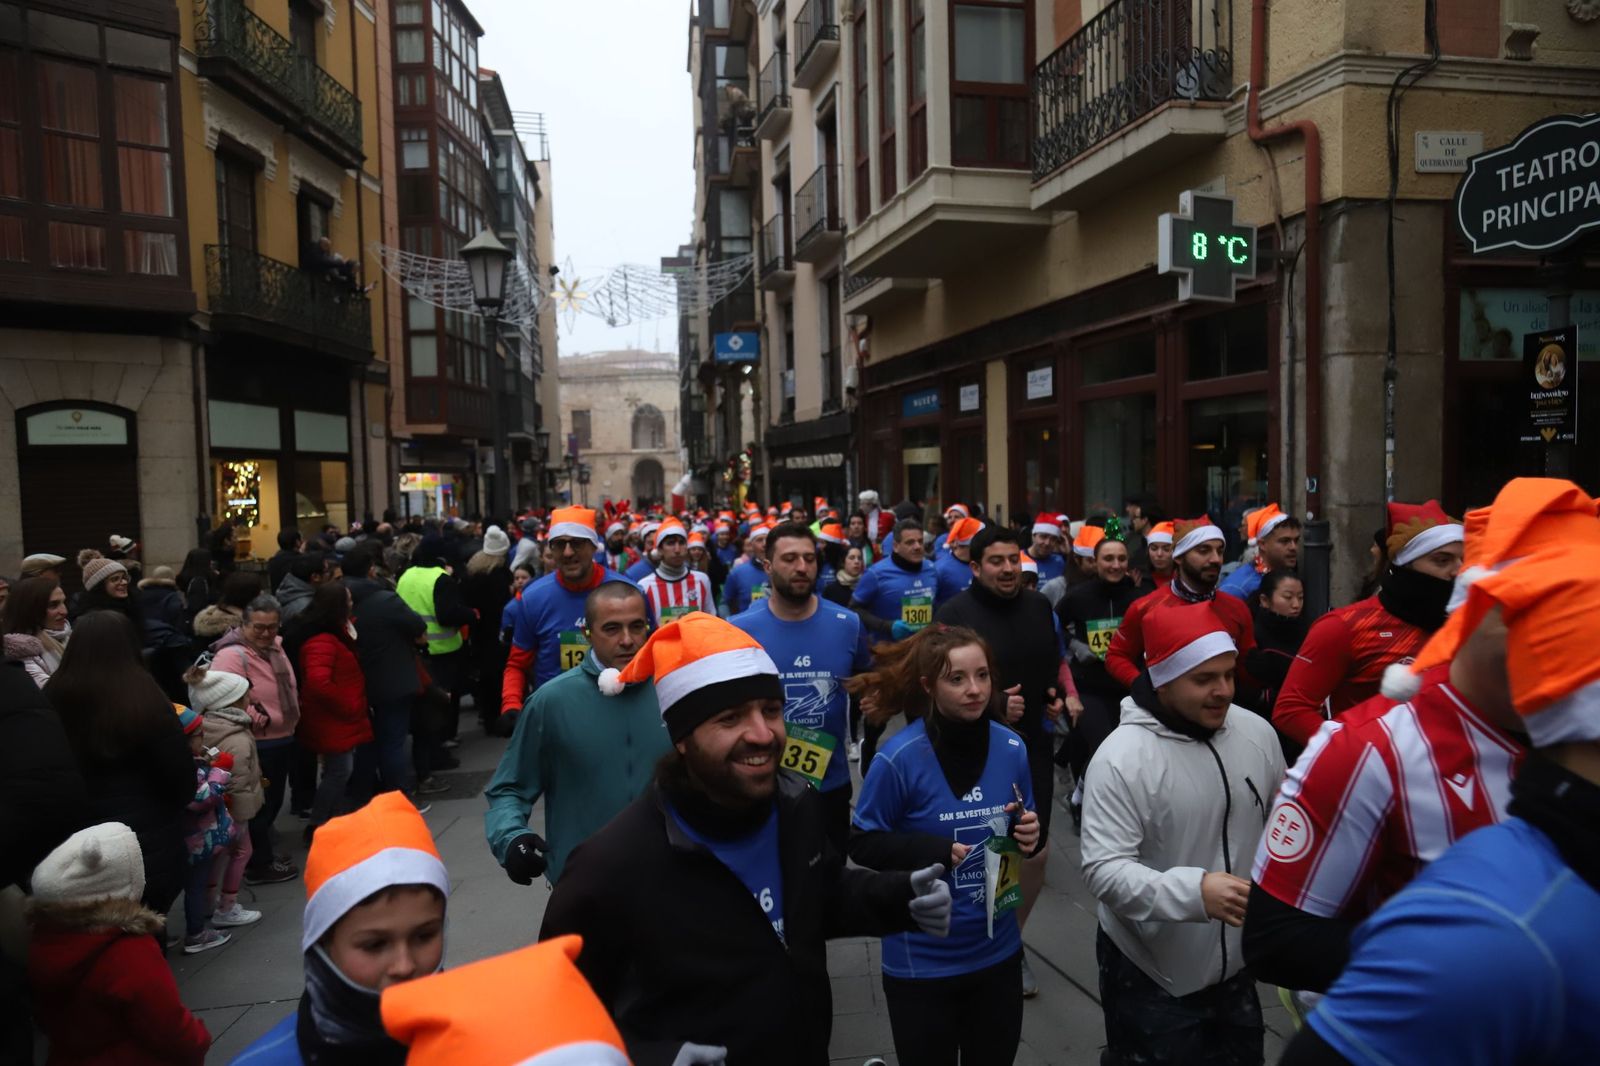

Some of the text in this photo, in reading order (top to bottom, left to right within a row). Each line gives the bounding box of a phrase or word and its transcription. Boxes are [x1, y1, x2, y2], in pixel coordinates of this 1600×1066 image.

[1440, 137, 1468, 146] CALLE
[1445, 148, 1457, 157] DE
[1496, 141, 1600, 192] TEATRO
[1192, 232, 1207, 260] 8
[1503, 301, 1518, 313] Un
[1530, 317, 1545, 330] de
[905, 609, 928, 623] 1301
[794, 656, 811, 667] 46
[962, 786, 983, 803] 46
[939, 813, 954, 821] SAN
[955, 807, 991, 820] SILVESTRE
